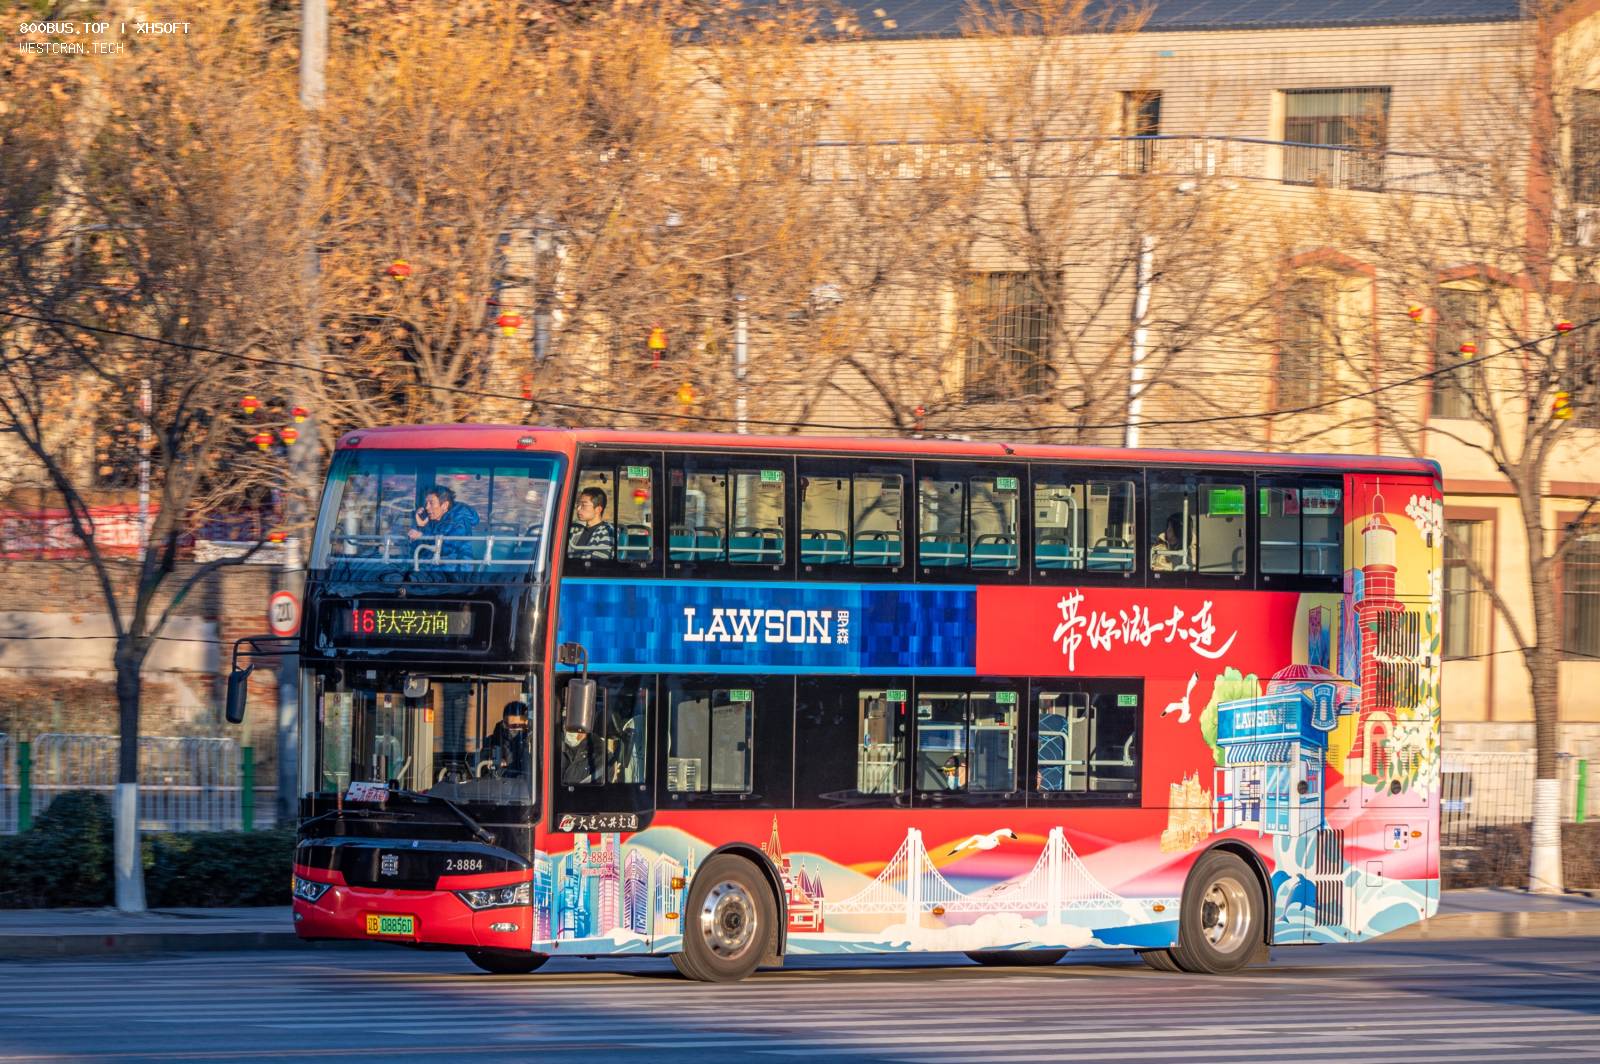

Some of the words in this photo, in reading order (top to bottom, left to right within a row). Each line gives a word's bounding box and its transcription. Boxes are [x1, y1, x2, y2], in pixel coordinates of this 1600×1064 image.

[352, 609, 375, 633] 16
[683, 607, 832, 644] LAWSON
[836, 610, 850, 645] 罗森
[1052, 588, 1238, 672] 带你游大连
[446, 858, 483, 871] 2-8884
[581, 850, 614, 865] 2-8884
